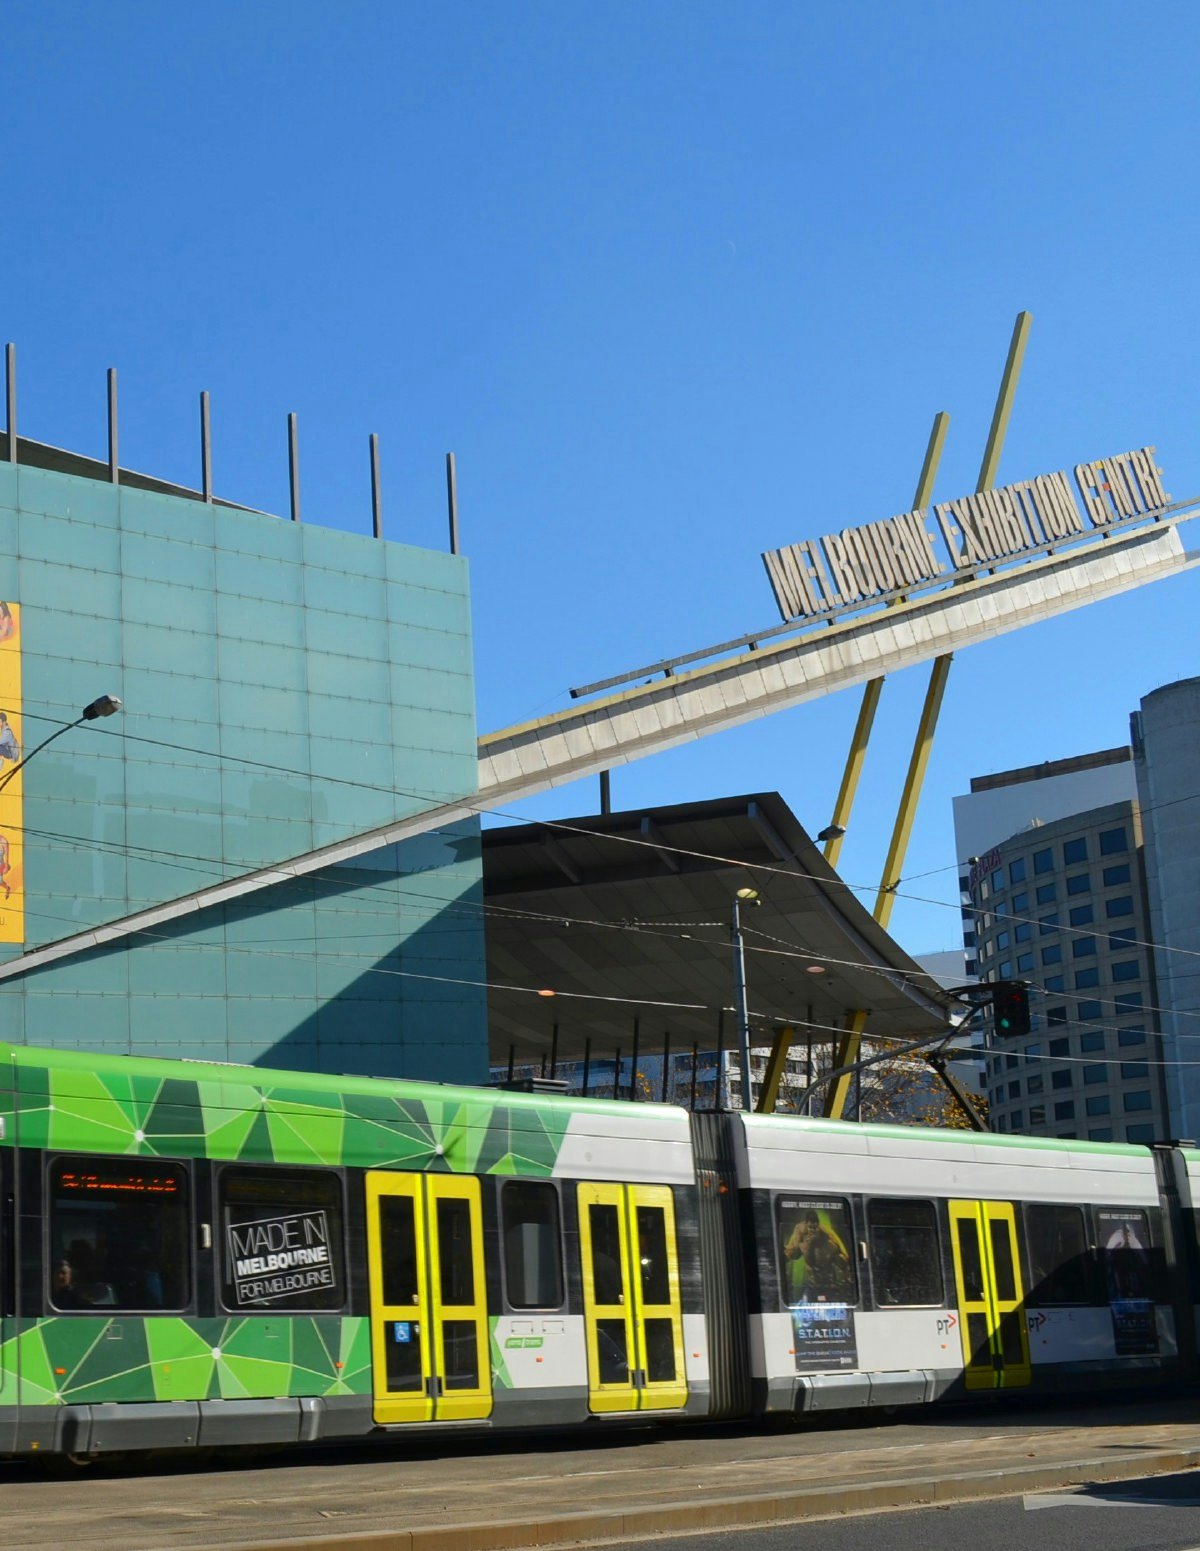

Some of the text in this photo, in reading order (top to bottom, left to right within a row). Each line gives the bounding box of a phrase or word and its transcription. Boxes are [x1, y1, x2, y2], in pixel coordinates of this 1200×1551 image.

[761, 446, 1171, 622] MELBOURNE EXHIBITION CENTRE
[232, 1216, 326, 1257] MADE IN
[237, 1246, 328, 1276] MELBOURNE
[240, 1268, 331, 1298] FOR MELBOURNE
